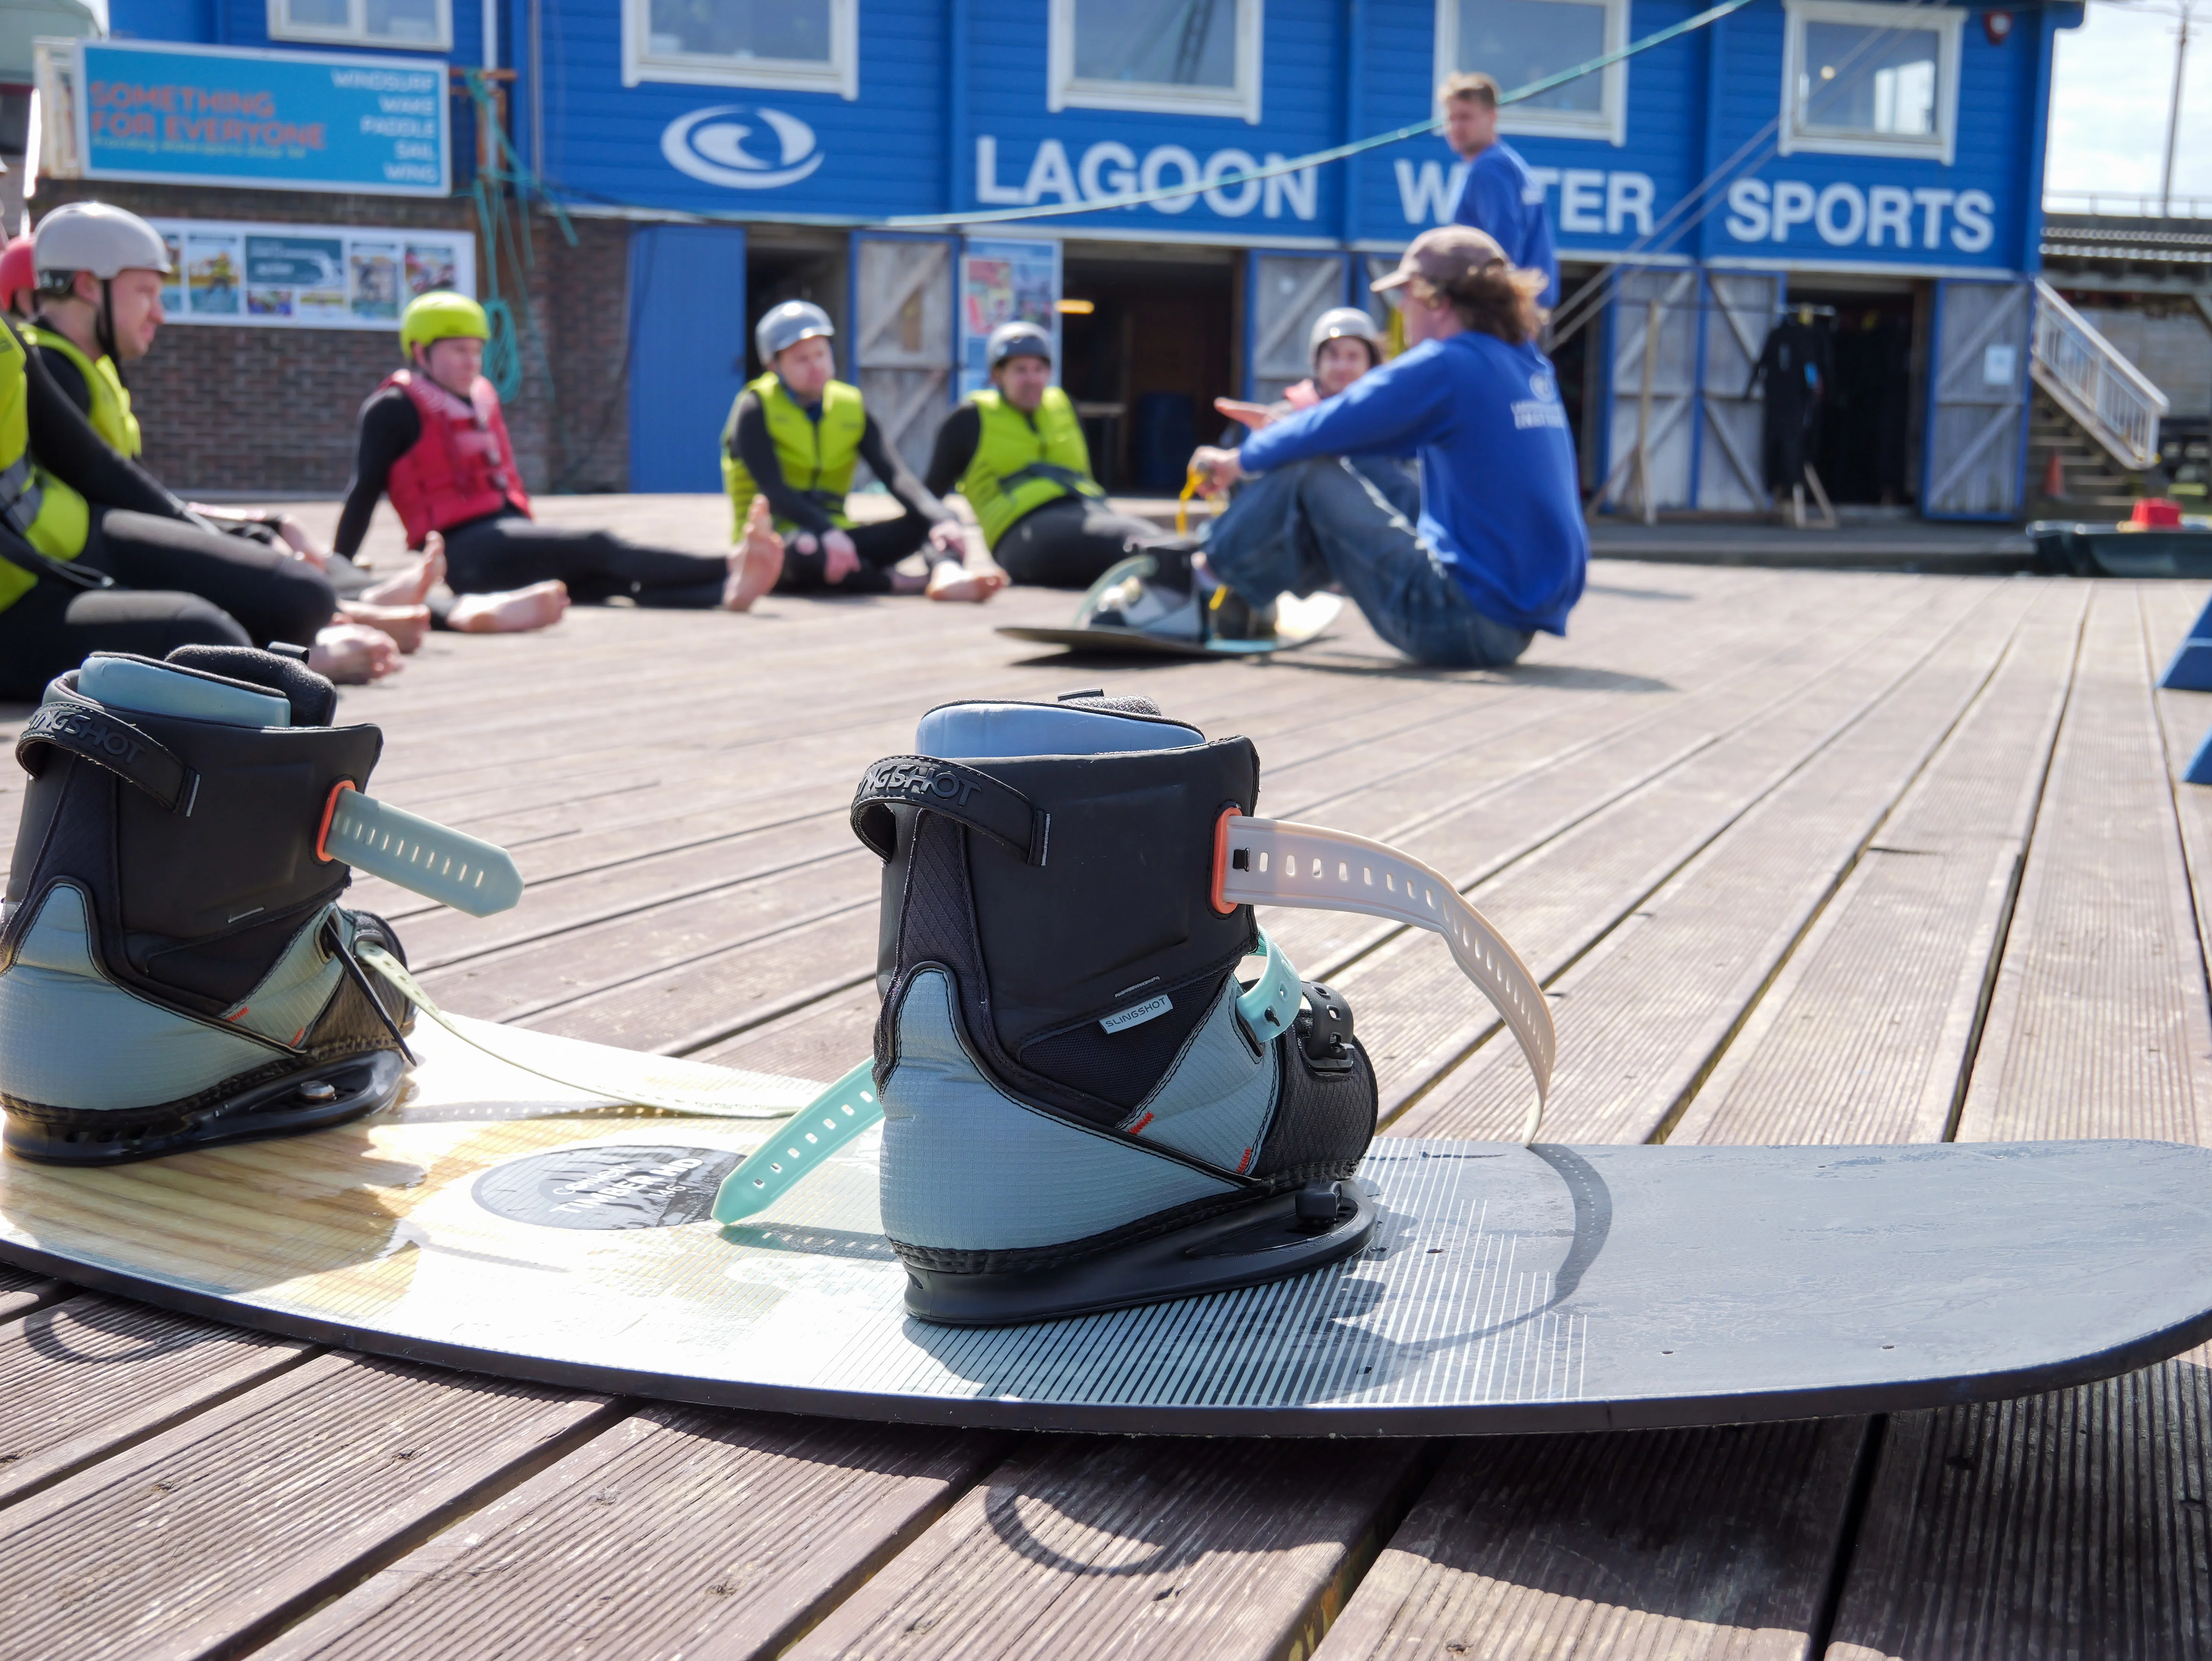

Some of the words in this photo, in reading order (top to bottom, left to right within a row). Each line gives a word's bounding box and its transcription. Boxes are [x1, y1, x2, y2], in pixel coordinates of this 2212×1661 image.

[330, 67, 434, 93] WINDSURF
[90, 80, 275, 119] SOMETHING
[378, 95, 434, 116] WAKE
[91, 111, 155, 138] FOR
[164, 115, 325, 150] EVERYONE
[360, 115, 435, 139] PADDLE
[394, 139, 436, 161] SAIL
[384, 162, 438, 183] WING
[975, 135, 1318, 221] LAGOON
[1393, 157, 1656, 236] WTER
[1725, 177, 1996, 253] SPORTS
[28, 709, 147, 764] INGSHOT
[856, 765, 982, 807] INGSHOT
[1105, 997, 1166, 1027] SLINGSHOT
[548, 1174, 664, 1213] TIMBER
[650, 1157, 704, 1177] HD
[648, 1185, 687, 1198] 146
